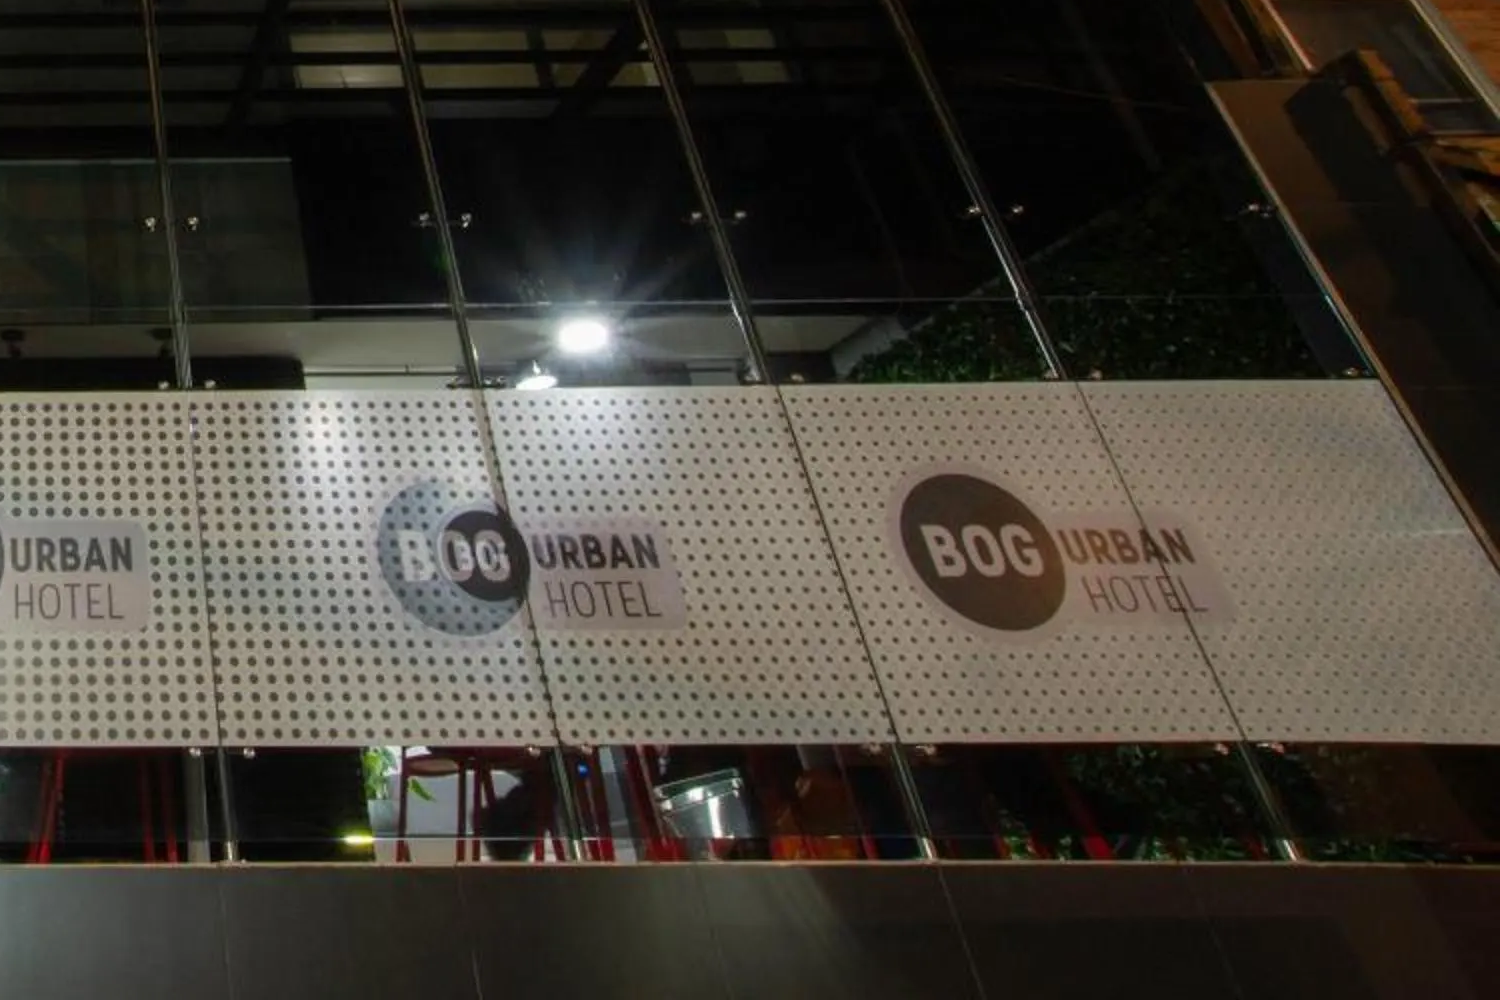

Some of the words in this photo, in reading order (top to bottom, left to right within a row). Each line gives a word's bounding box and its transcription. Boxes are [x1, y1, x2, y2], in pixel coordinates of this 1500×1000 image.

[9, 536, 134, 573] URBAN
[531, 533, 661, 569] URBAN
[919, 523, 1045, 578] BOG
[1056, 528, 1196, 565] URBAN
[14, 582, 126, 620] HOTEL
[544, 580, 664, 618] HOTEL
[1082, 575, 1210, 613] HOTEL
